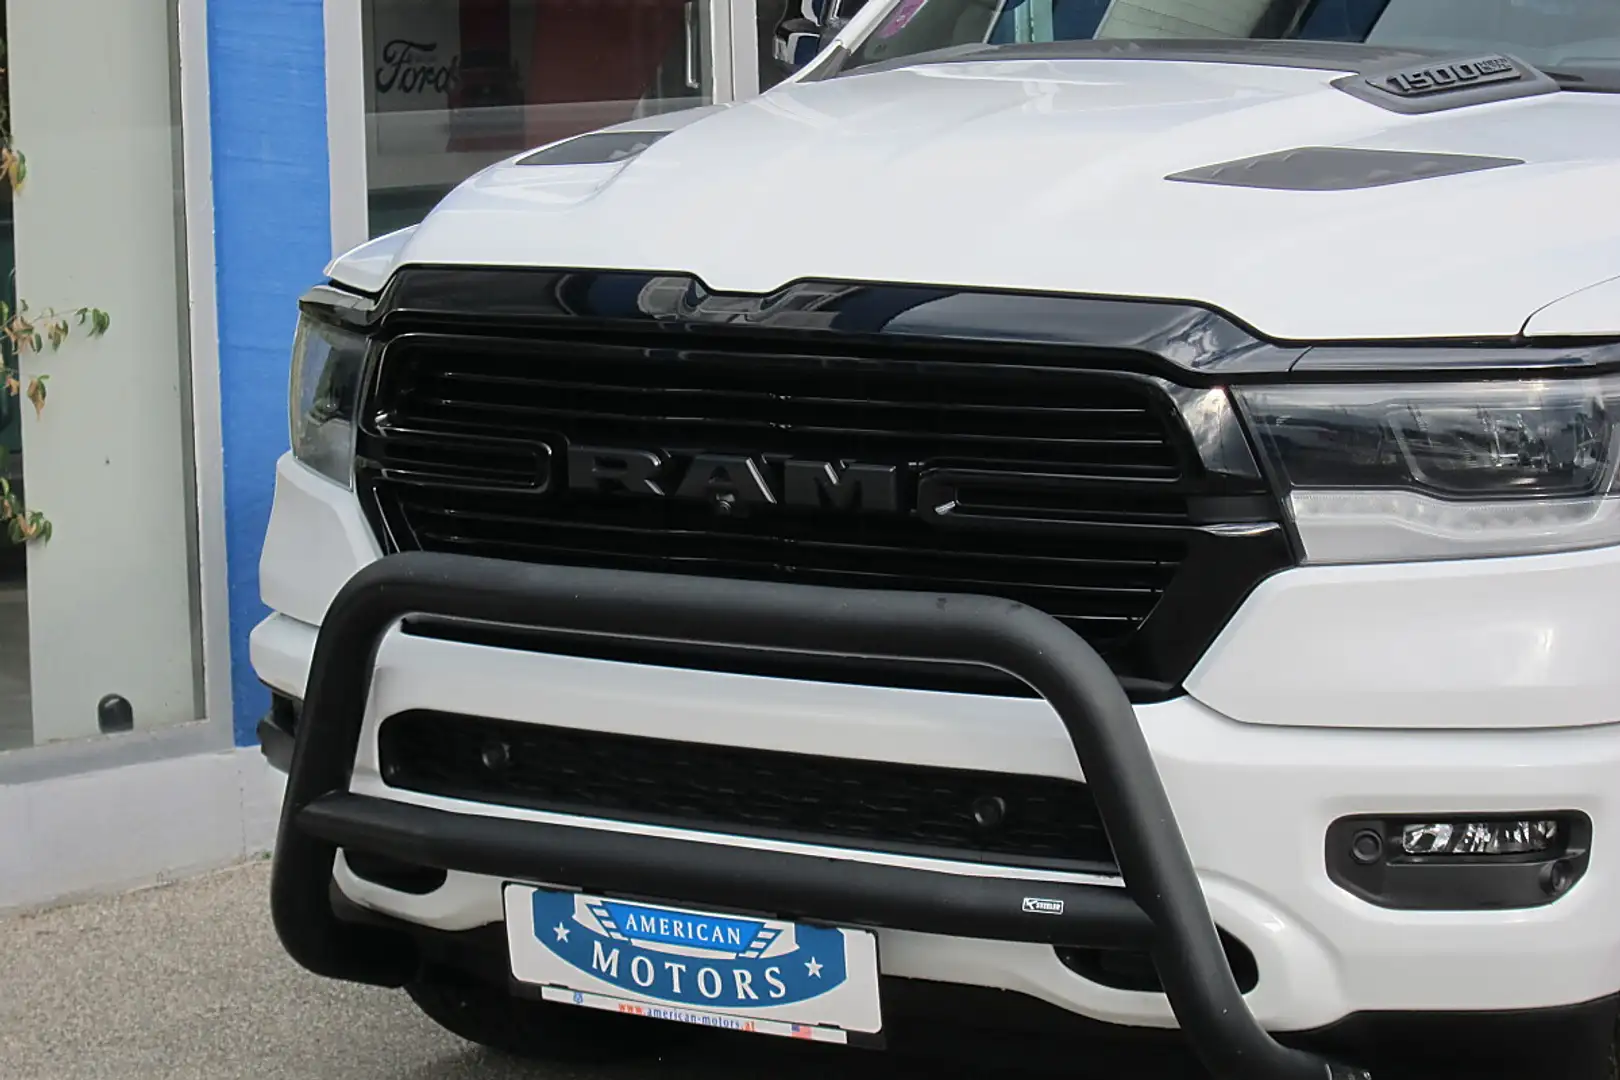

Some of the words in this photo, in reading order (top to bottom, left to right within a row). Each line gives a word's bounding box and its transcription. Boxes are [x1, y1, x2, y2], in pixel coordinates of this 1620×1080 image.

[375, 39, 458, 94] Ford
[1387, 63, 1479, 91] 1500
[568, 445, 896, 511] RAM
[626, 913, 741, 944] AMERICAN
[592, 941, 787, 999] MOTORS
